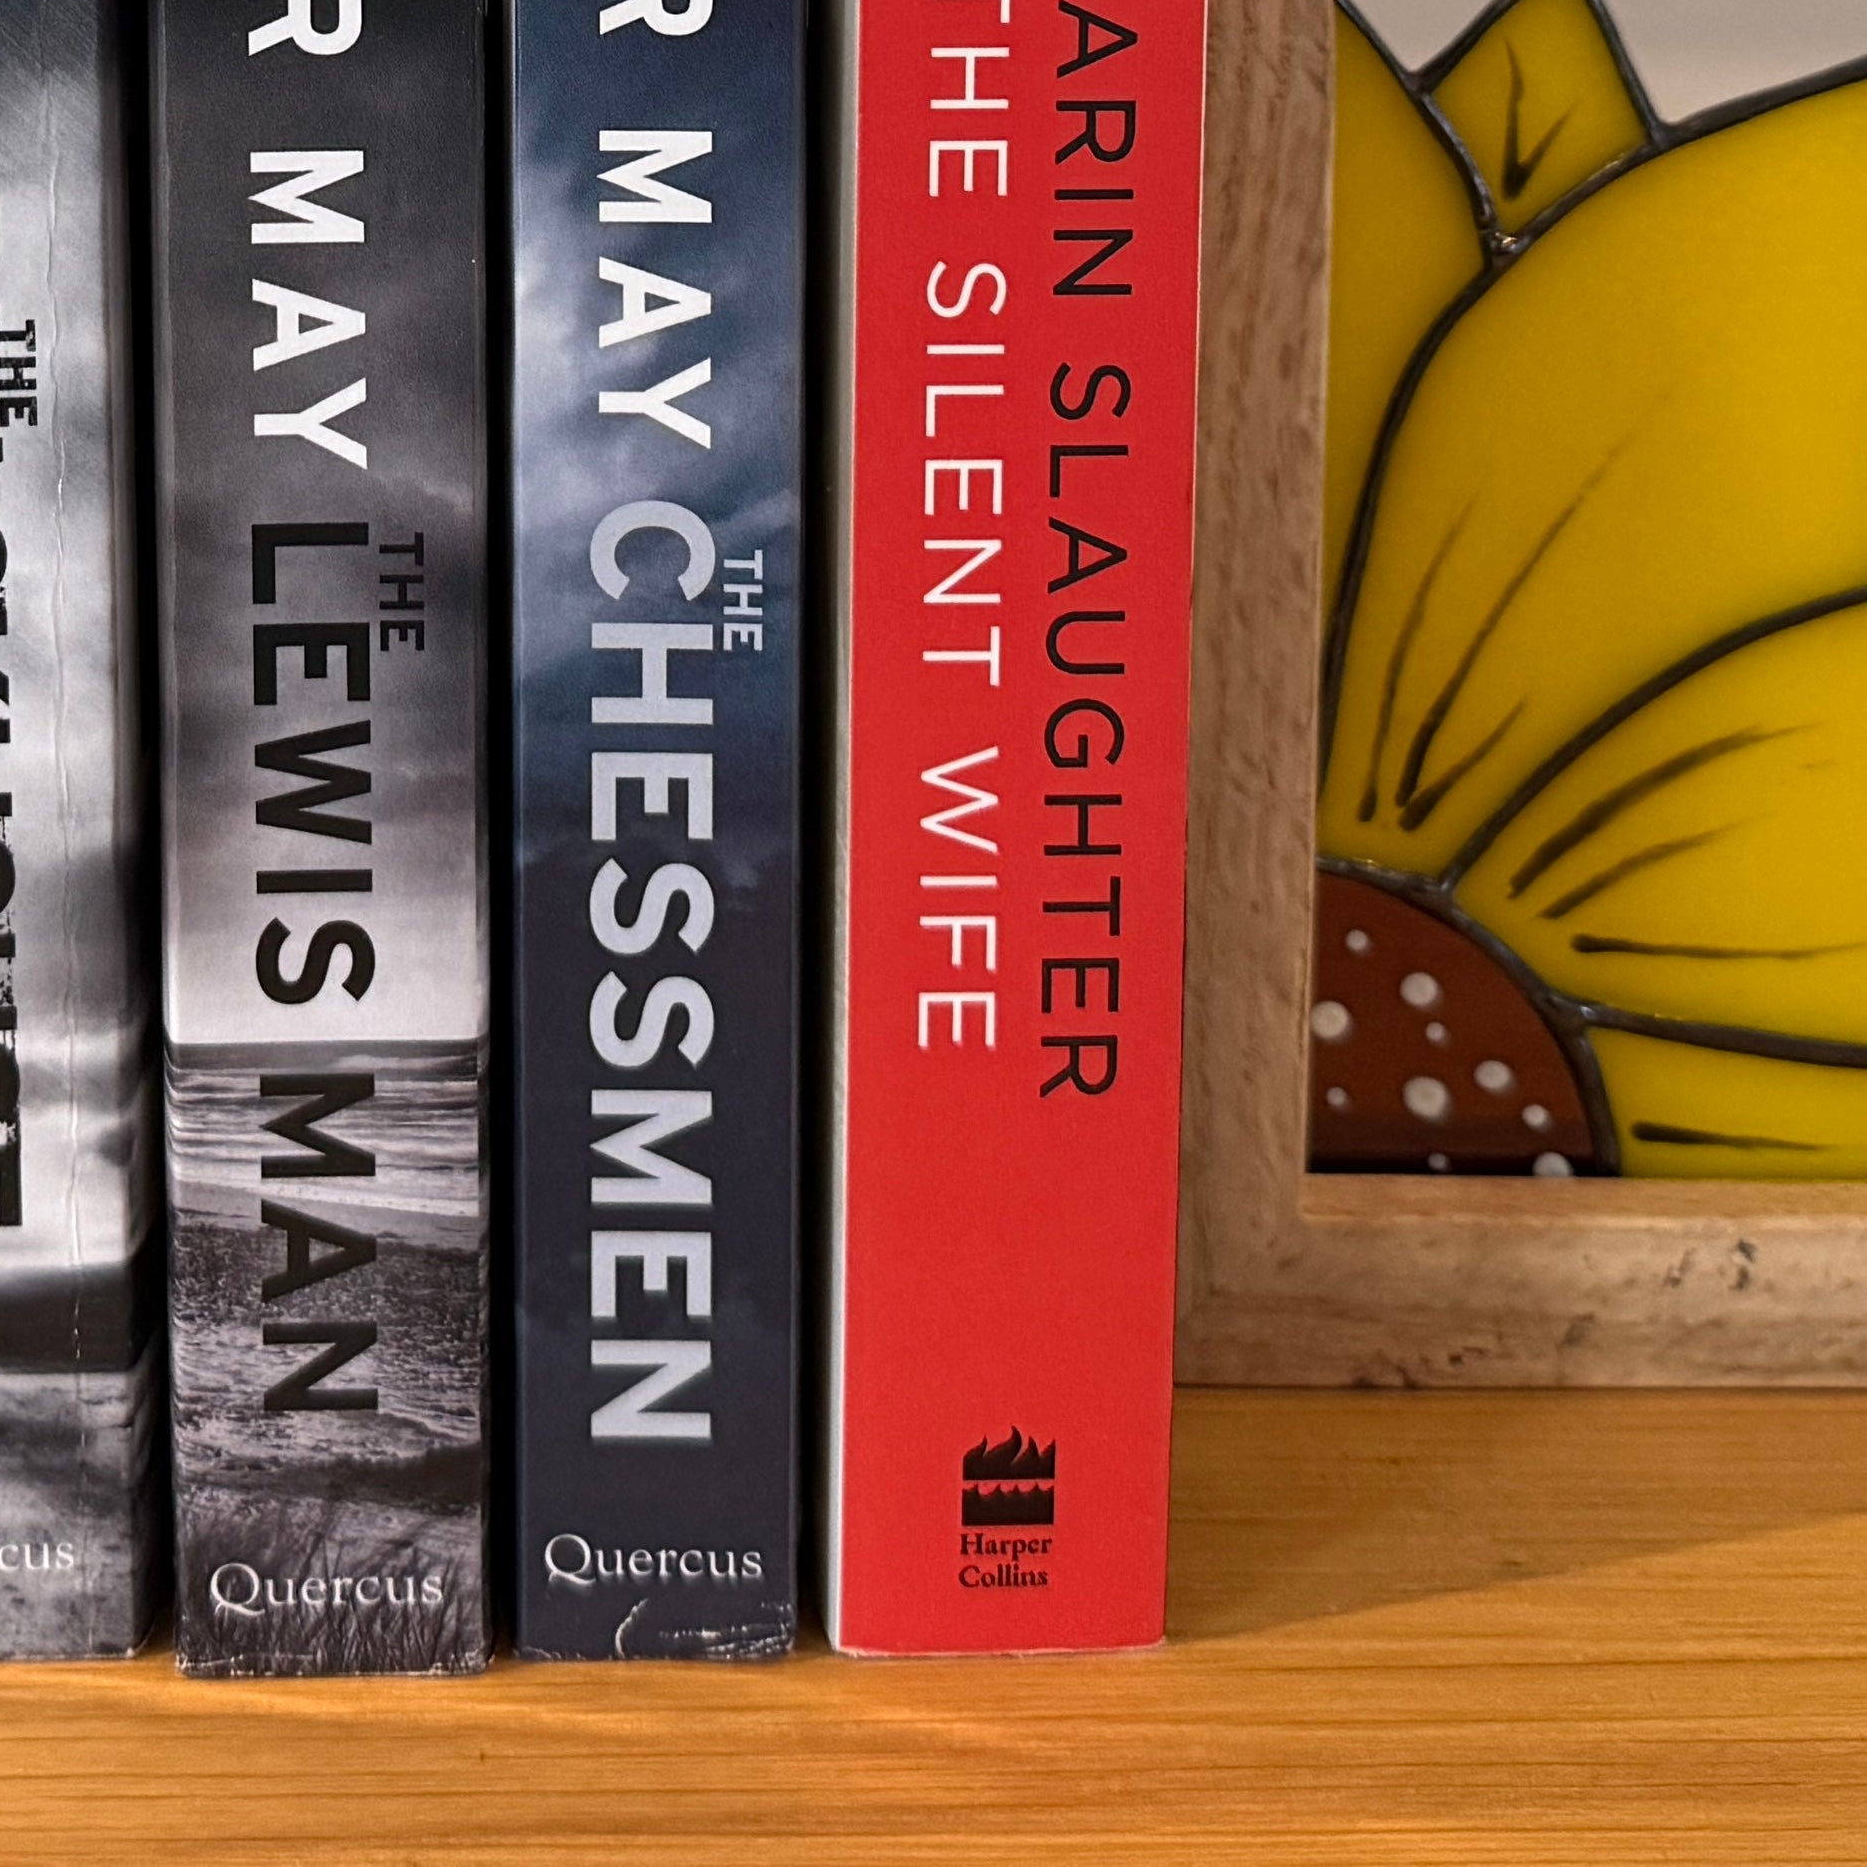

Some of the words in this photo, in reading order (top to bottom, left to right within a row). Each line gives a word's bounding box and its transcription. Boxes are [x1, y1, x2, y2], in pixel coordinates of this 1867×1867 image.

[247, 150, 368, 470] MAY
[596, 130, 713, 449] MAY
[379, 532, 425, 651] THE
[722, 549, 763, 652] THE
[922, 261, 1007, 686] SILENT
[251, 522, 376, 1004] LEWIS
[1040, 362, 1132, 1098] SLAUGHTER
[589, 500, 715, 1438] CHESSMEN
[918, 746, 1000, 1050] WIFE
[259, 1073, 378, 1411] MAN
[209, 1563, 444, 1615] Quercus
[543, 1532, 763, 1585] Quercus
[957, 1563, 1049, 1589] Collins
[959, 1533, 1053, 1562] Harper
